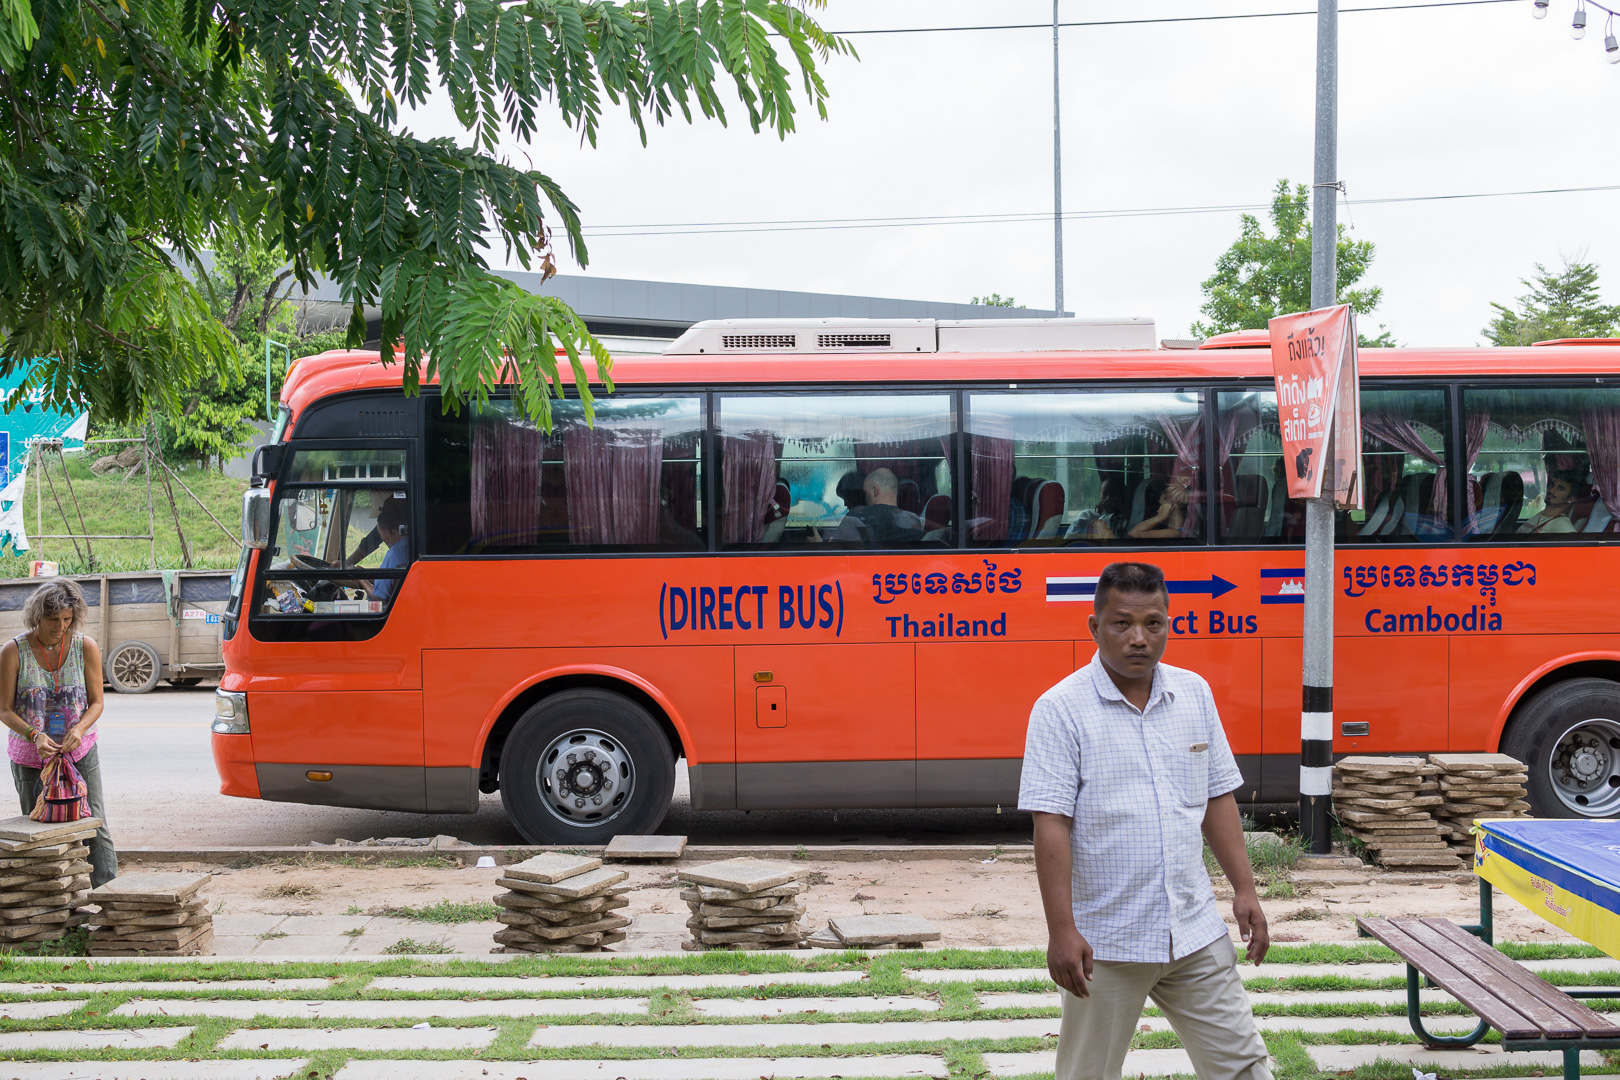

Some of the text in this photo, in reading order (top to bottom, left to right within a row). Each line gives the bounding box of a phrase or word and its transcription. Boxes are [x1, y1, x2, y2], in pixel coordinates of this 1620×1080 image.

[1283, 407, 1307, 442] สเต็ก
[1343, 560, 1536, 608] ប្រទេសកម្ពុជា
[659, 581, 844, 641] (DIRECT BUS)
[885, 612, 1006, 638] Thailand
[1209, 610, 1258, 634] Bus
[1365, 605, 1502, 633] Cambodia
